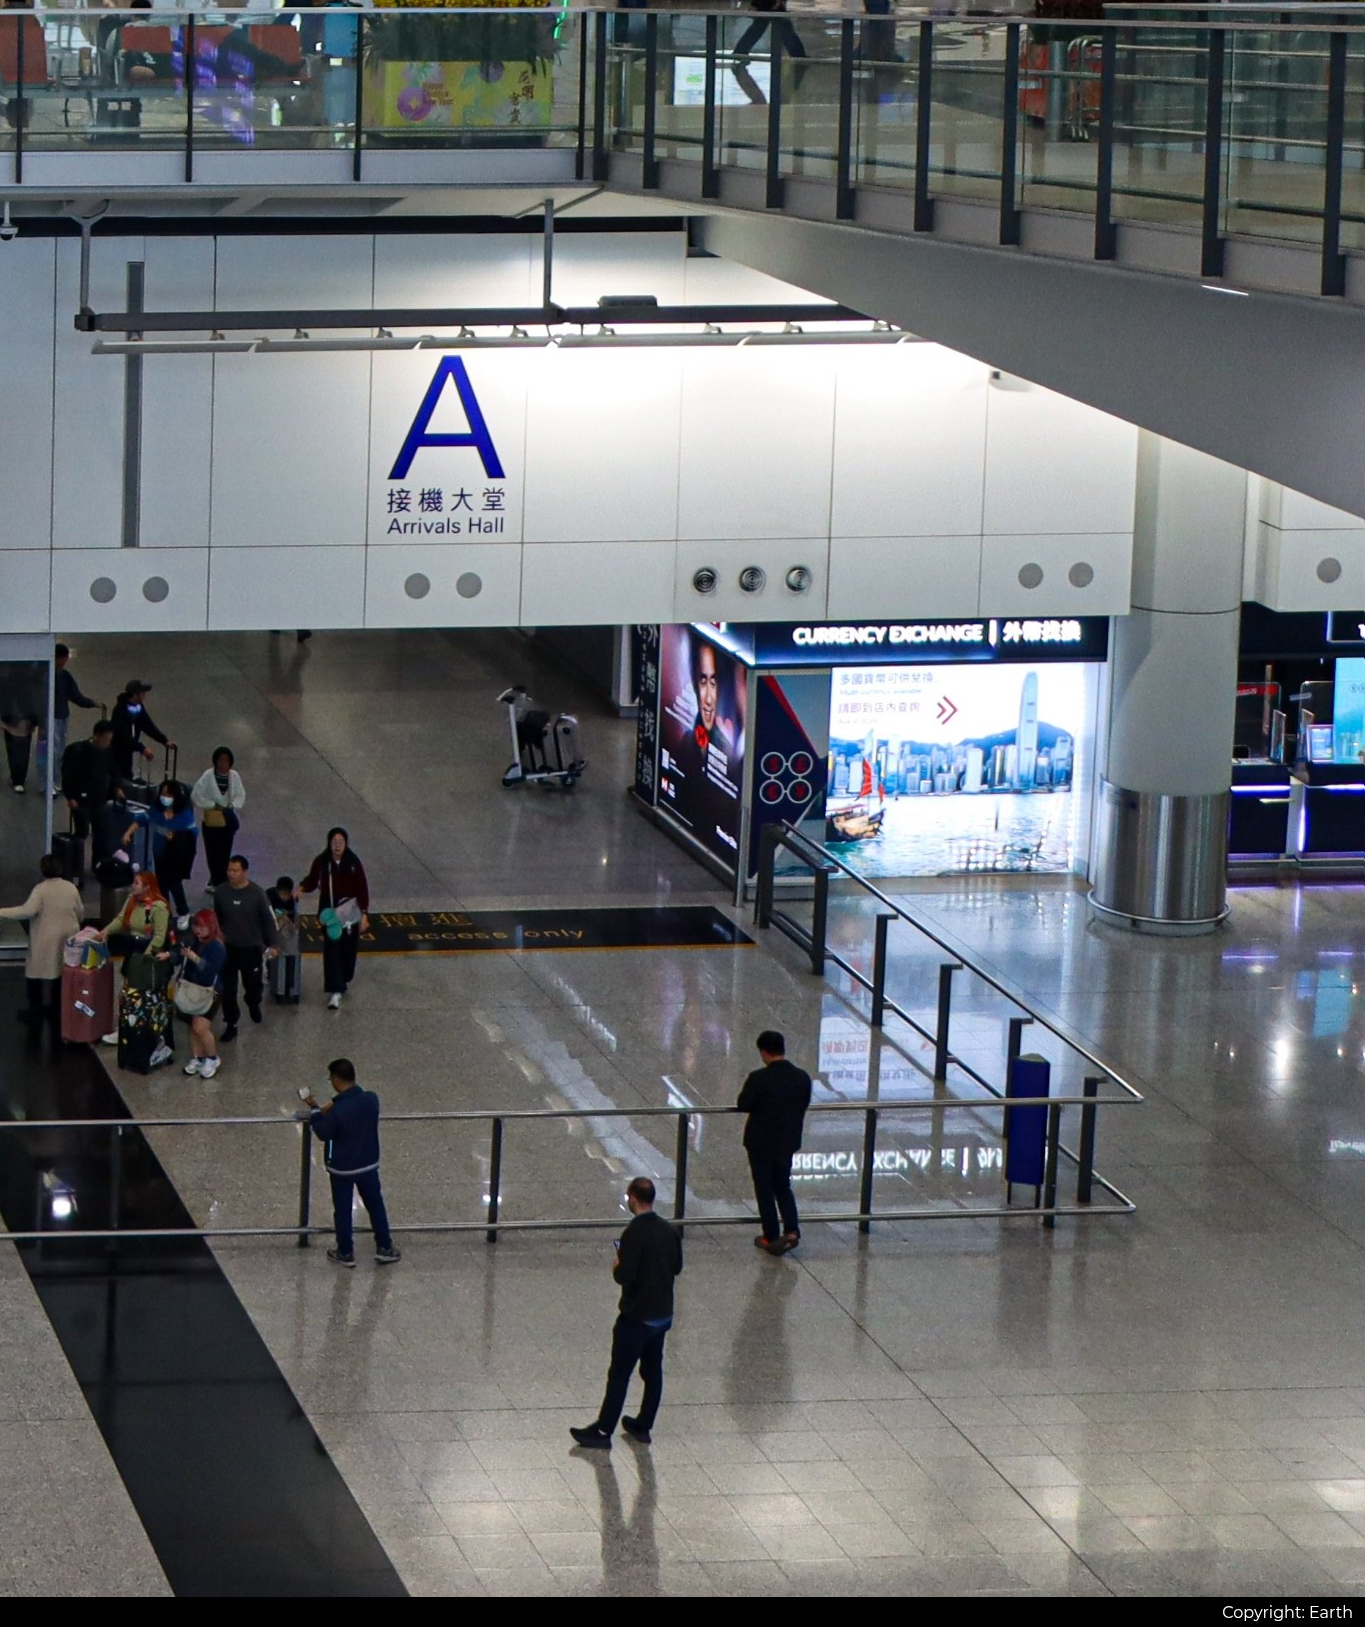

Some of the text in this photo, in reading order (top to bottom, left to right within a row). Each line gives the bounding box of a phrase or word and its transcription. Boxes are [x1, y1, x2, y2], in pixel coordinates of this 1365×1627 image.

[387, 355, 506, 480] A
[388, 487, 505, 514] 接機大堂
[387, 517, 504, 534] Arrivals Hall
[792, 627, 887, 645] CURRENCY
[889, 624, 984, 643] EXCHANGE
[407, 929, 584, 941] access only
